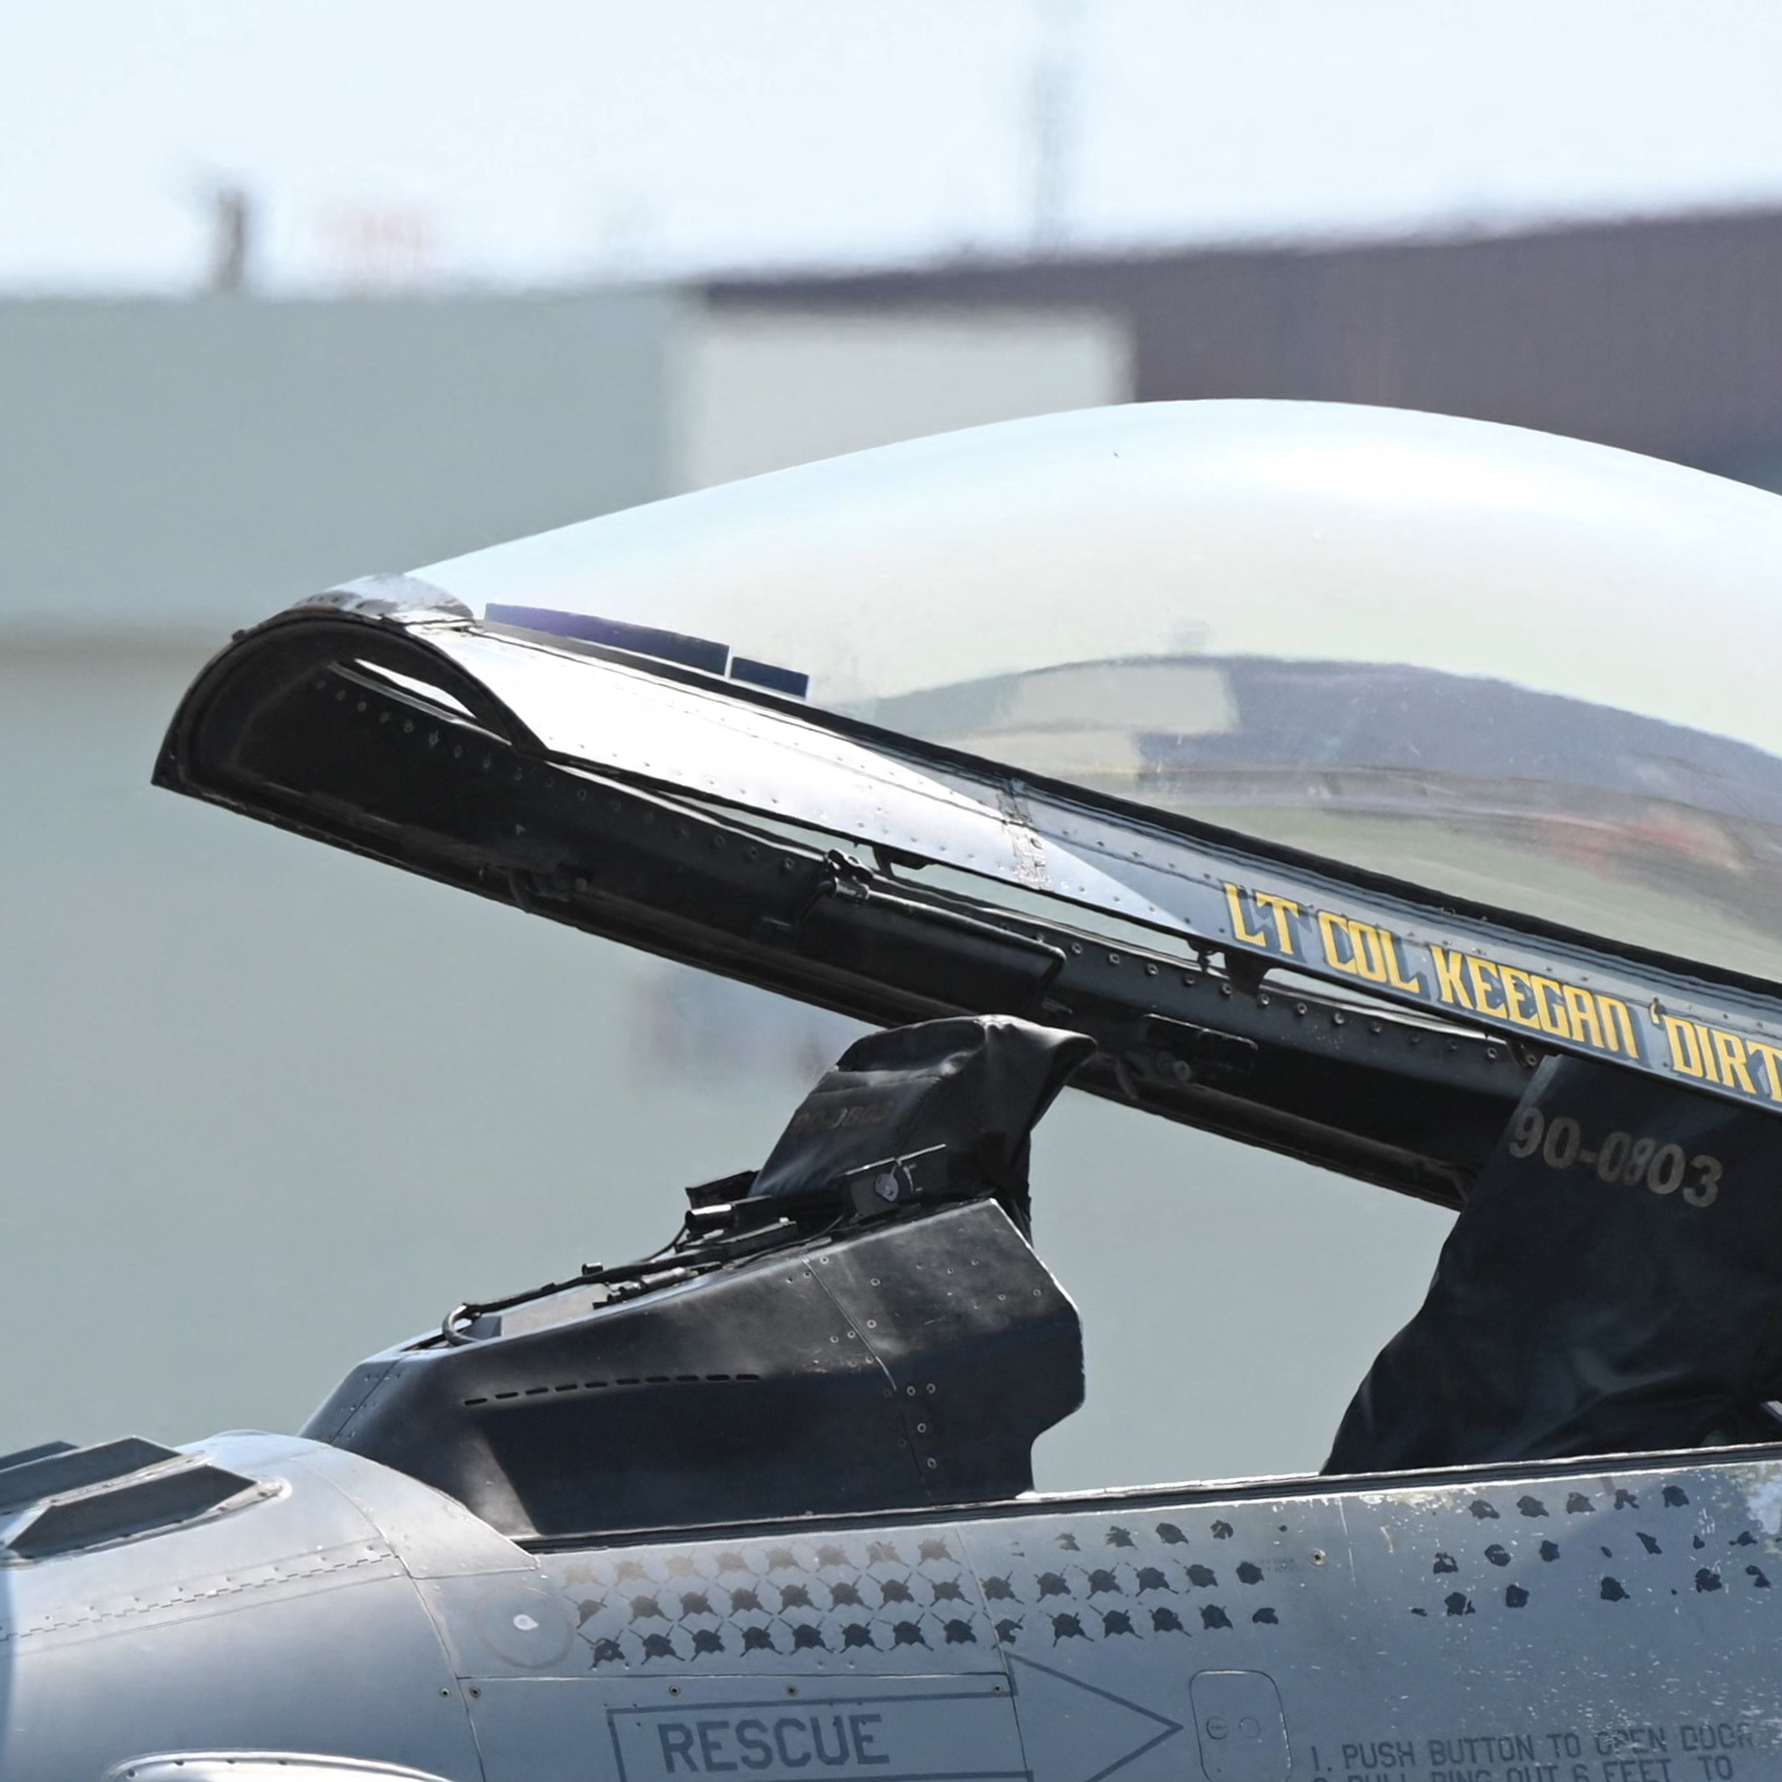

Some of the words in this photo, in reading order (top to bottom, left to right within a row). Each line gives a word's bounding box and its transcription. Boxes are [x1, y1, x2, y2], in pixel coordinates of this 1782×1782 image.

[1222, 881, 1301, 955] LT
[1318, 910, 1419, 993] COL
[1430, 945, 1639, 1060] KEEGAN
[1508, 1107, 1723, 1208] 90-0803
[657, 1713, 890, 1774] RESCUE
[1343, 1740, 1415, 1769] PUSH
[1428, 1734, 1535, 1765] BUTTON
[1546, 1732, 1580, 1758] TO
[1595, 1727, 1666, 1756] OPEN
[1697, 1755, 1734, 1782] TO
